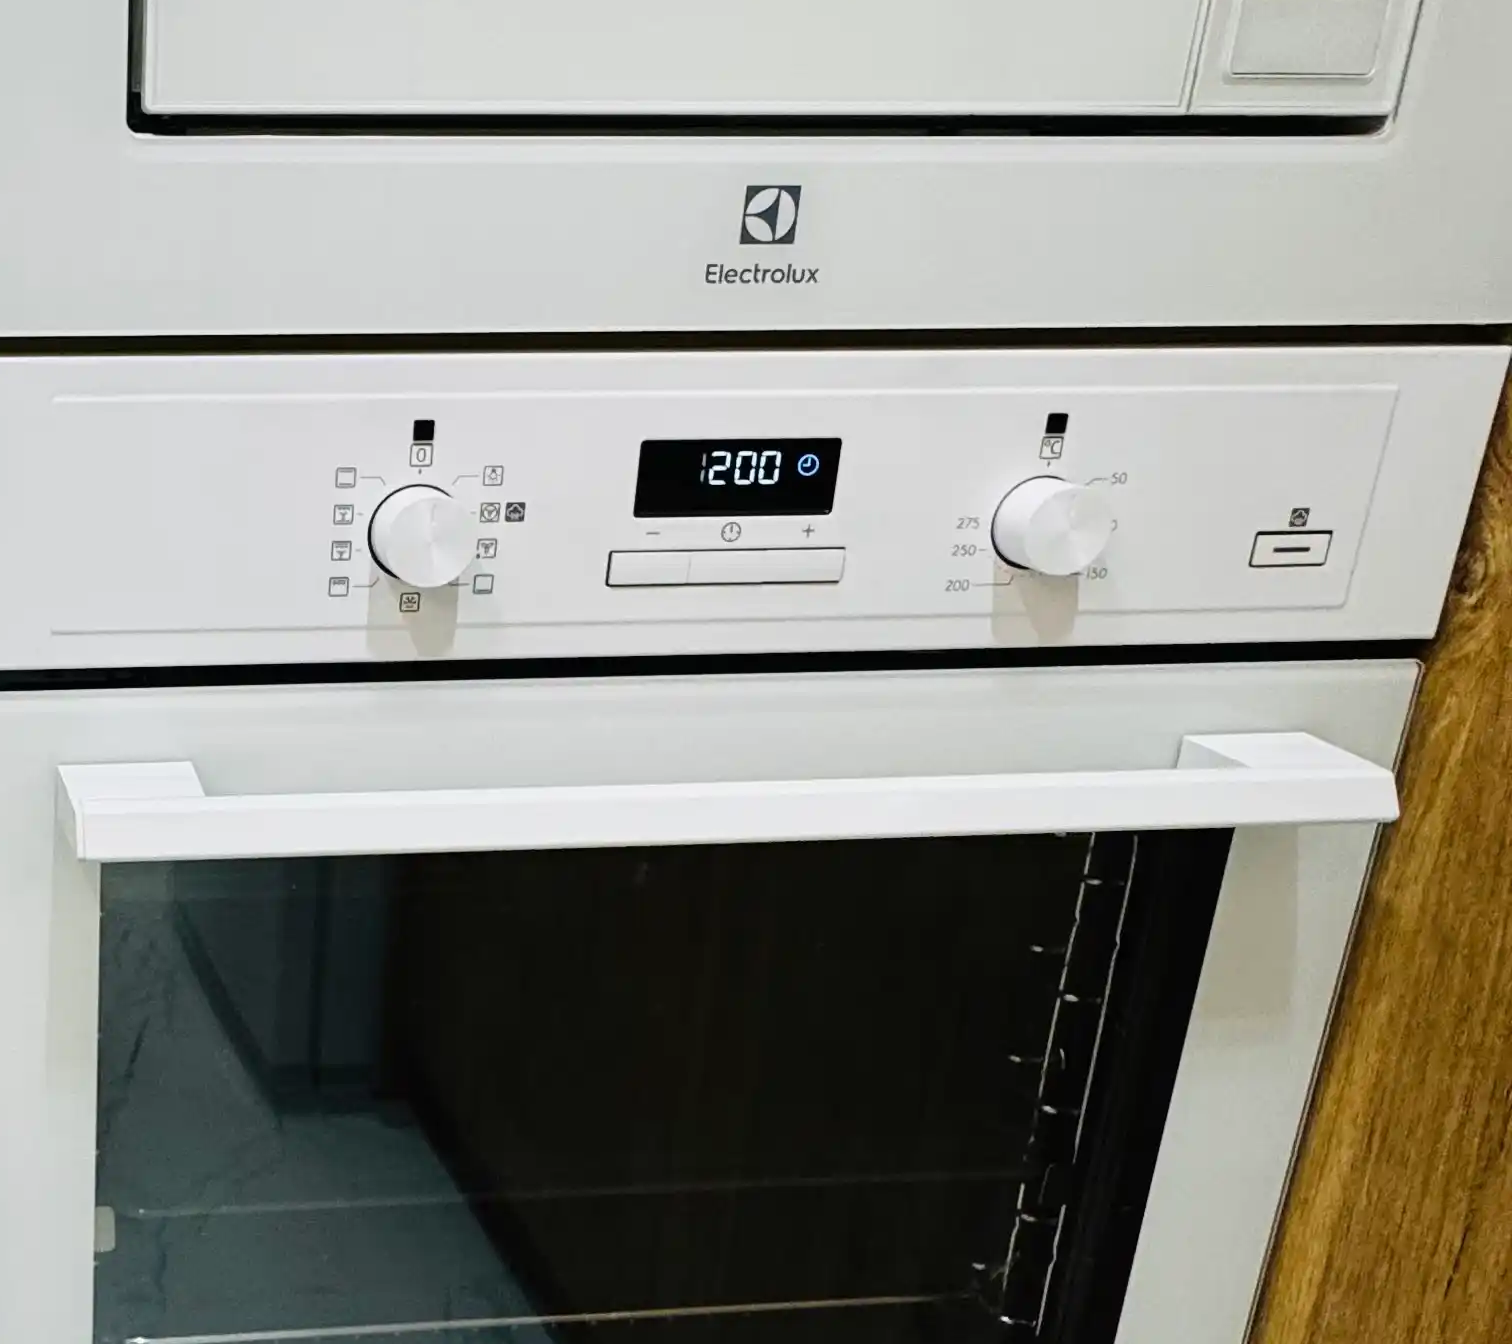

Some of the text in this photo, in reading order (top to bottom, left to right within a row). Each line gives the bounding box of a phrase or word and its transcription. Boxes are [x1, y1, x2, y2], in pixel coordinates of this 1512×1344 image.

[704, 263, 820, 284] Electrolux
[1111, 472, 1128, 486] 50
[956, 516, 980, 530] 275
[951, 544, 977, 557] 250
[945, 579, 970, 592] 200
